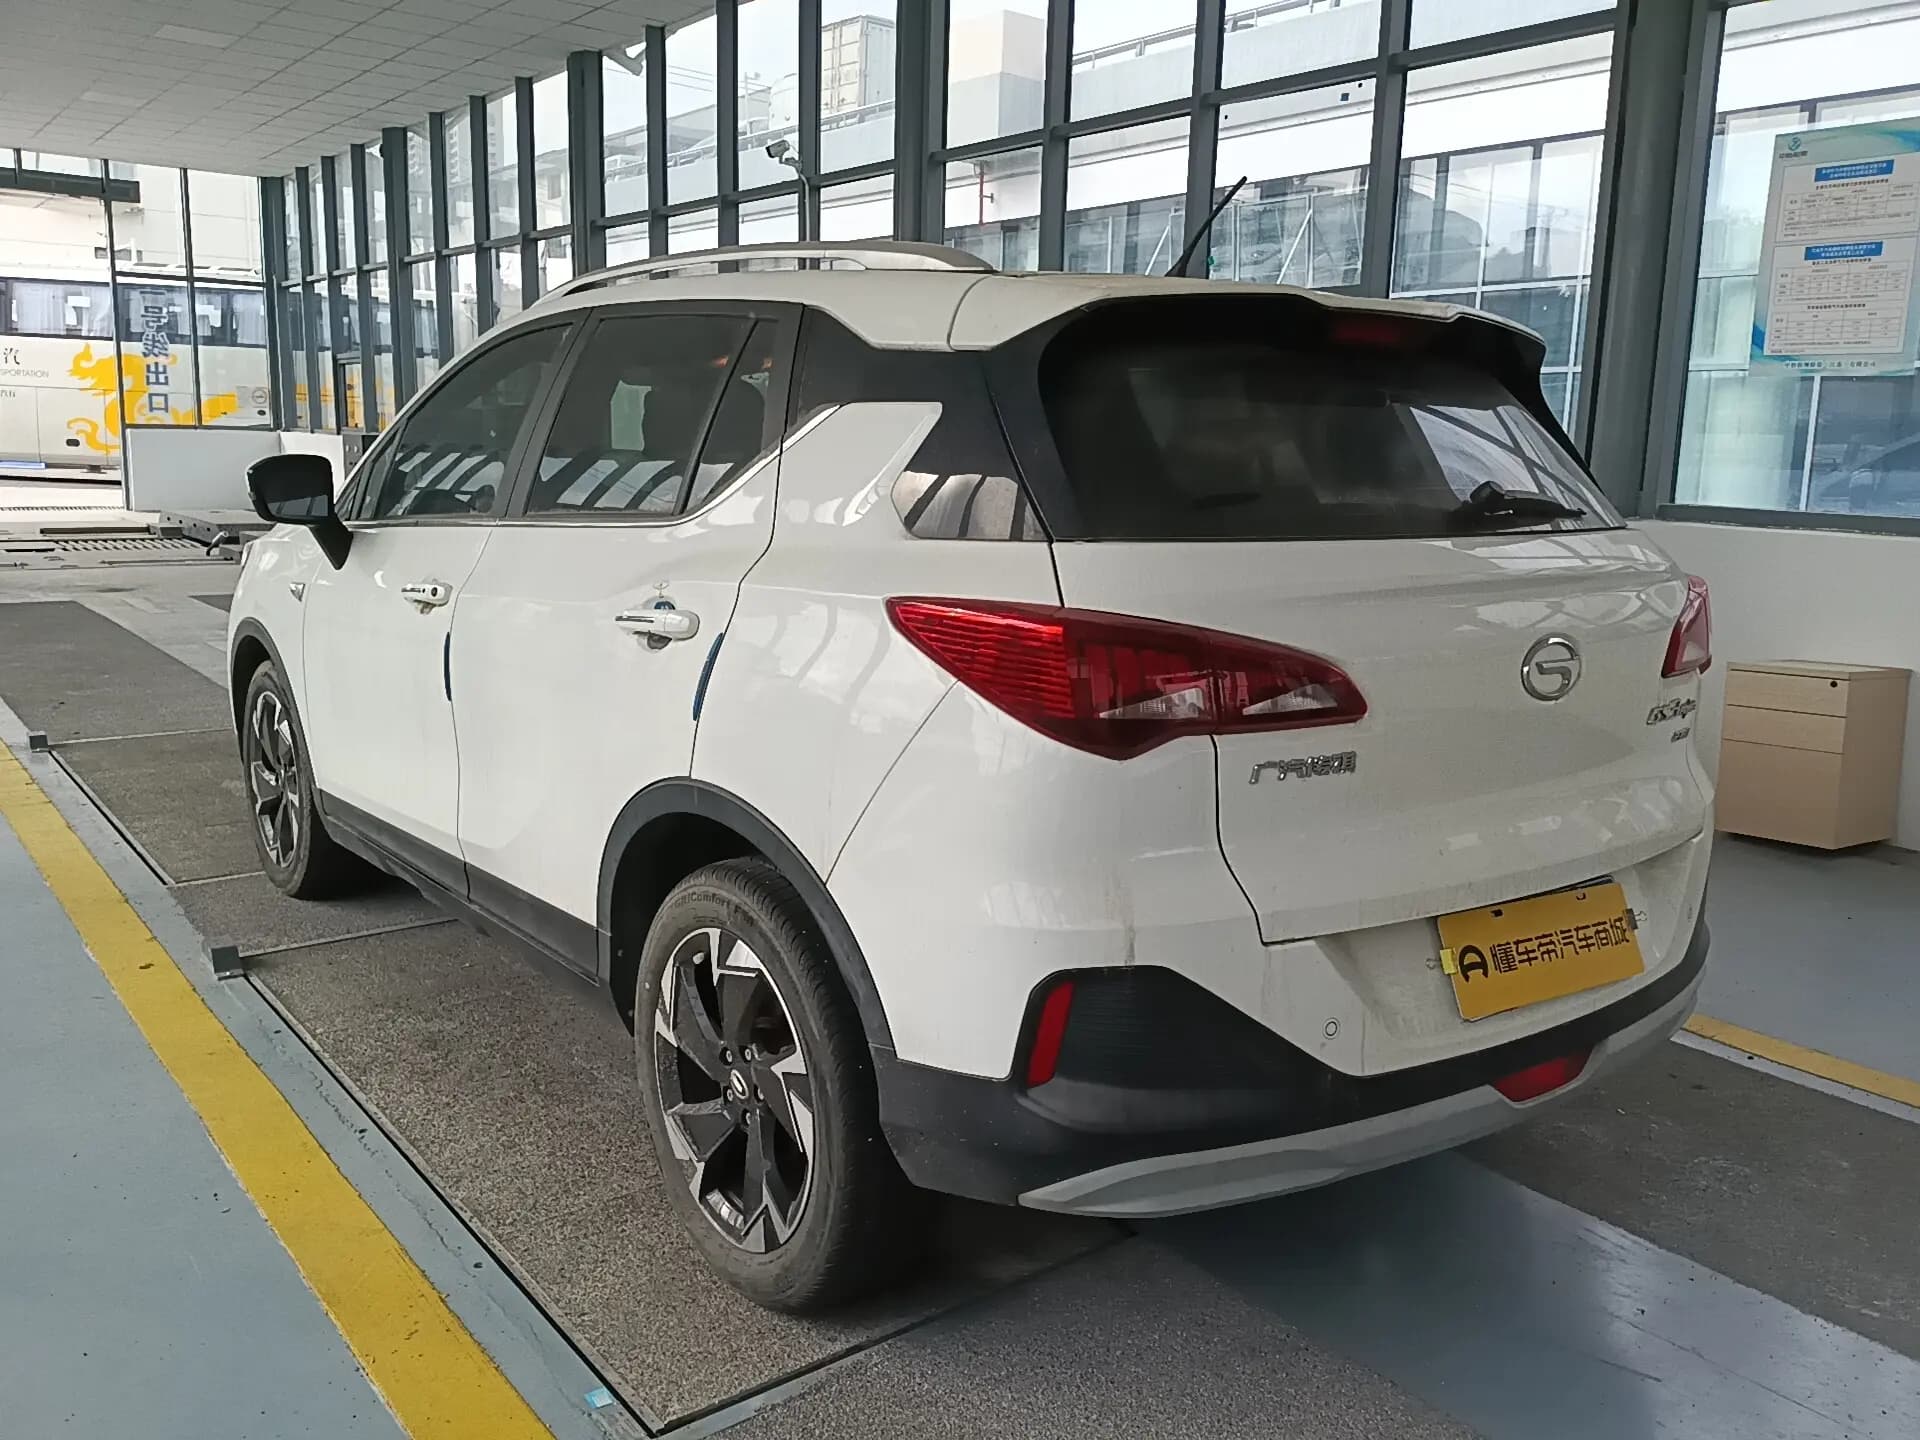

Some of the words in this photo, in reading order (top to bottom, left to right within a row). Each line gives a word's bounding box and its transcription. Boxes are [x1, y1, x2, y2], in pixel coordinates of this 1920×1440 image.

[1489, 916, 1630, 974] 懂车帝汽车商城
